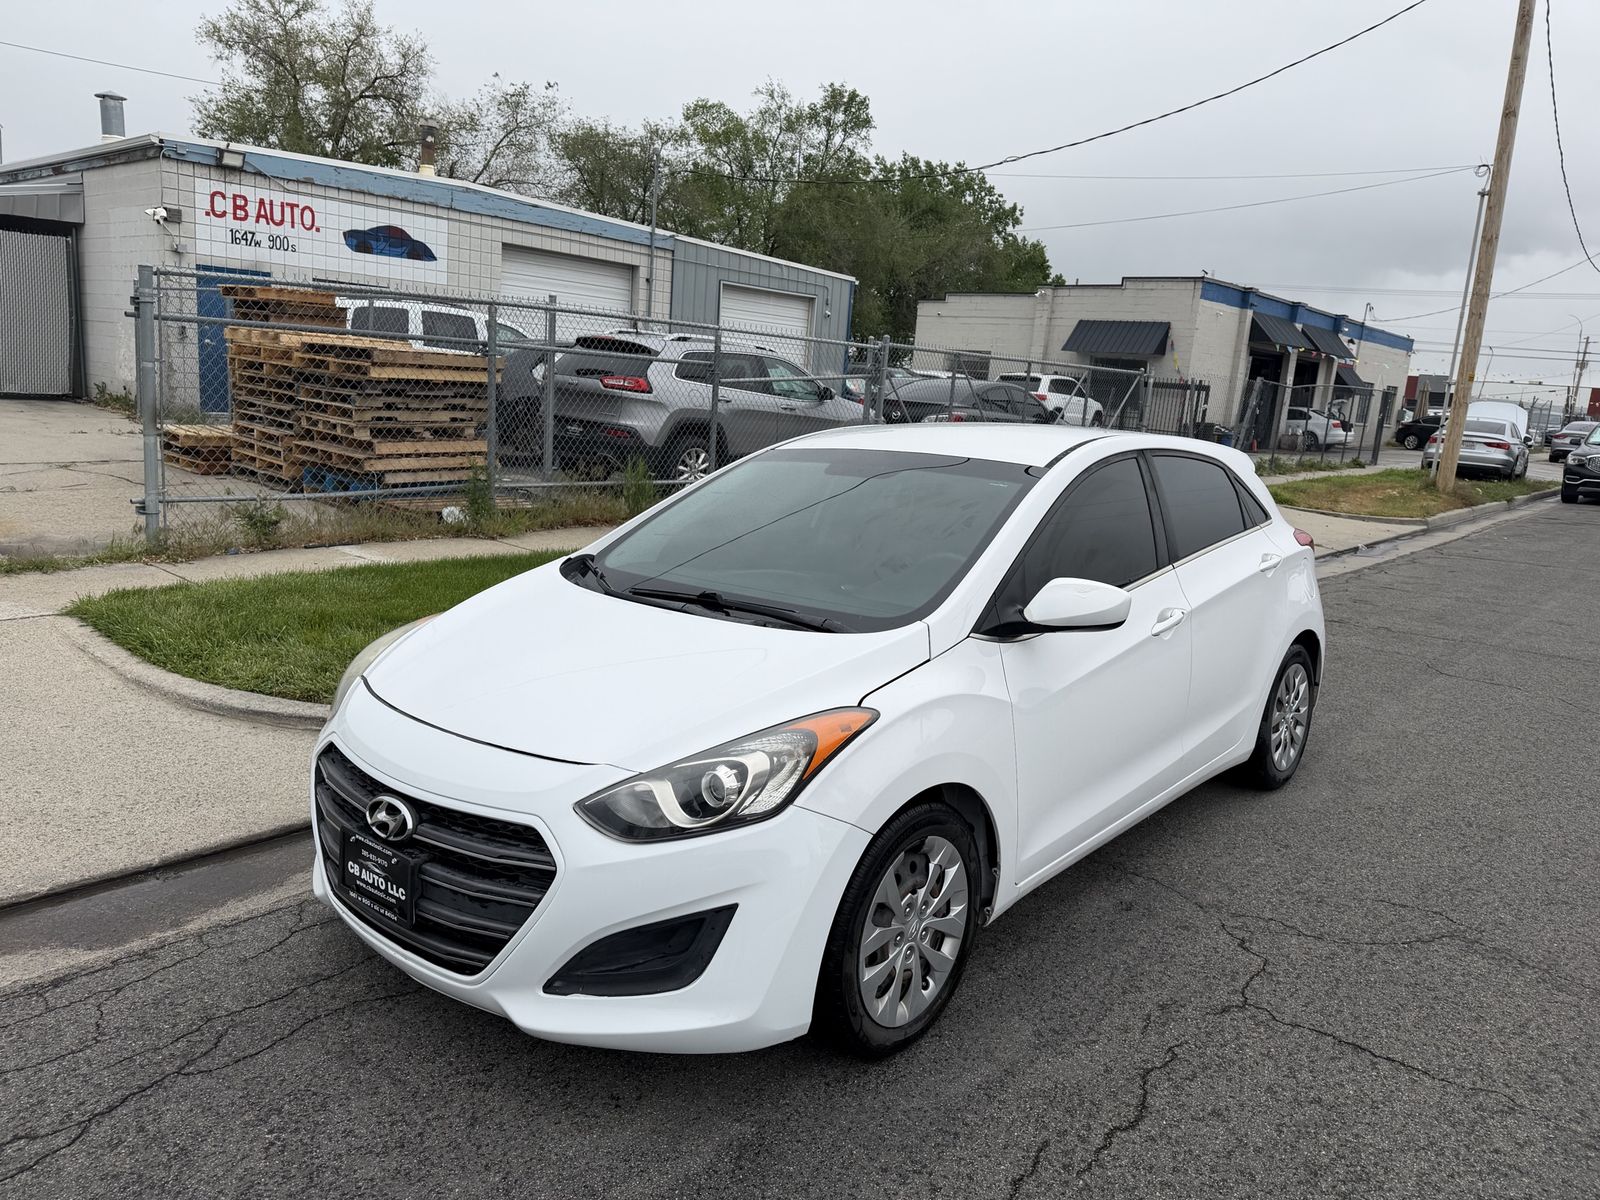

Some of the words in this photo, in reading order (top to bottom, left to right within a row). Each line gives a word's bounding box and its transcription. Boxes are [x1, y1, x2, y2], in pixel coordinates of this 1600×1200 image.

[229, 228, 262, 248] 1647w
[268, 234, 297, 253] 900s
[347, 860, 360, 877] CB
[361, 868, 386, 890] AUTO
[387, 881, 406, 901] LLC
